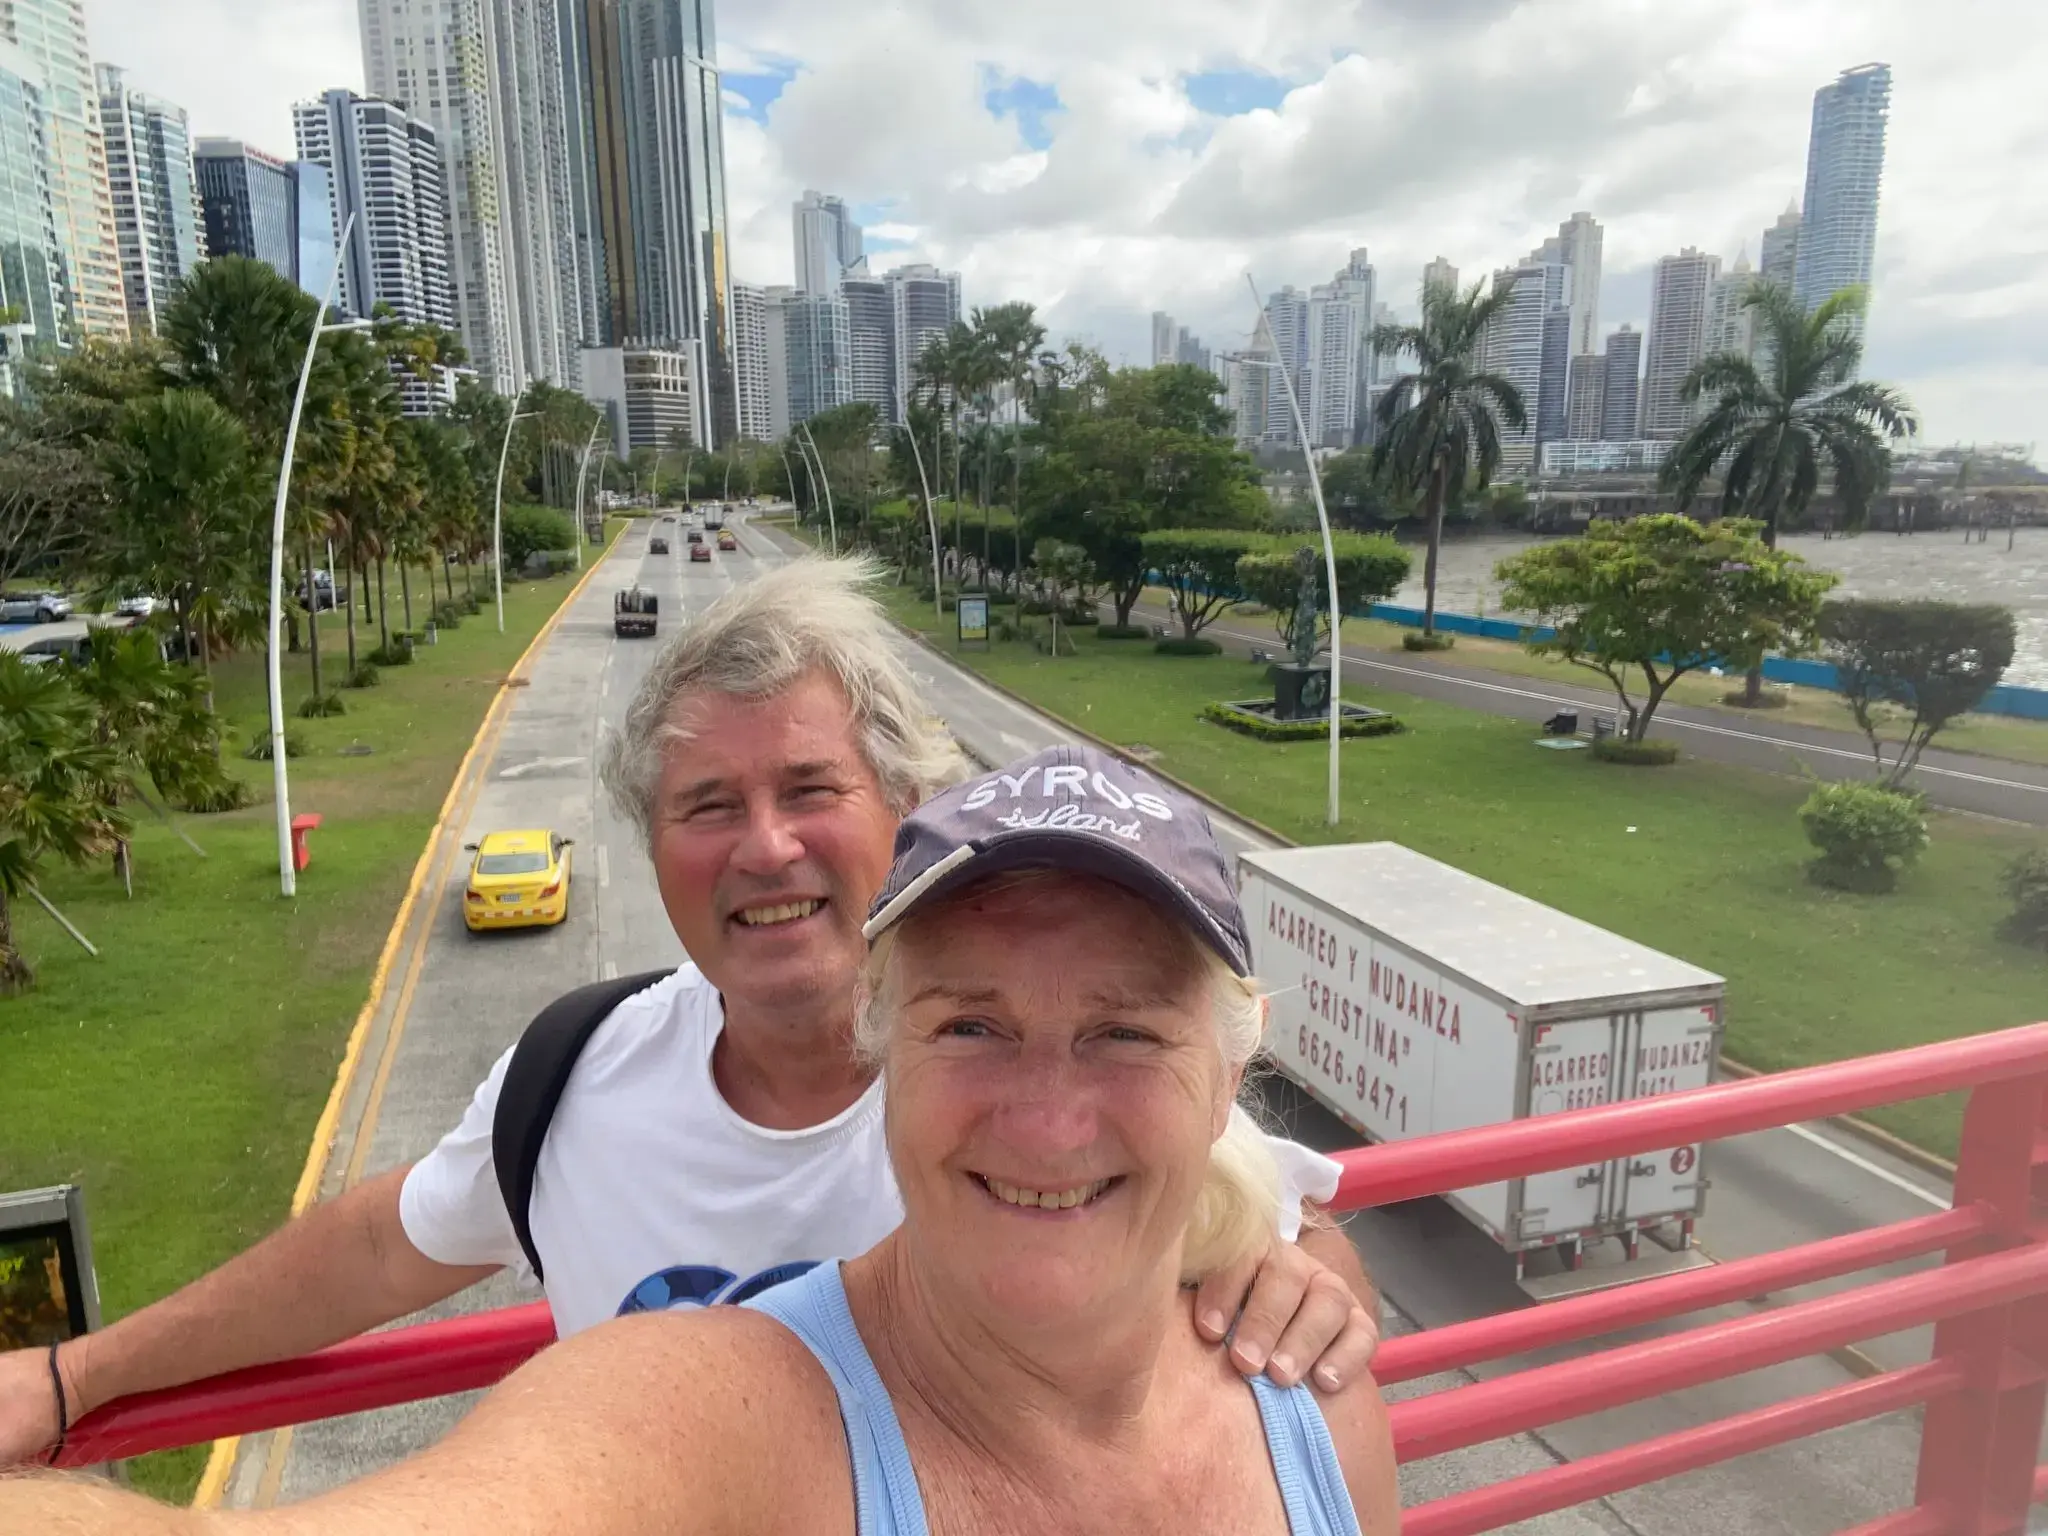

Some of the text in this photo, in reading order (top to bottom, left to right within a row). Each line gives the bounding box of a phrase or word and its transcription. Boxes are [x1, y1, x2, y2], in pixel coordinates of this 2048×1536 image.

[960, 765, 1173, 821] SYROS
[1268, 902, 1461, 1045] ACARREO Y MUDANZA
[1533, 1052, 1608, 1088] ACARREO
[1678, 1148, 1689, 1172] 2
